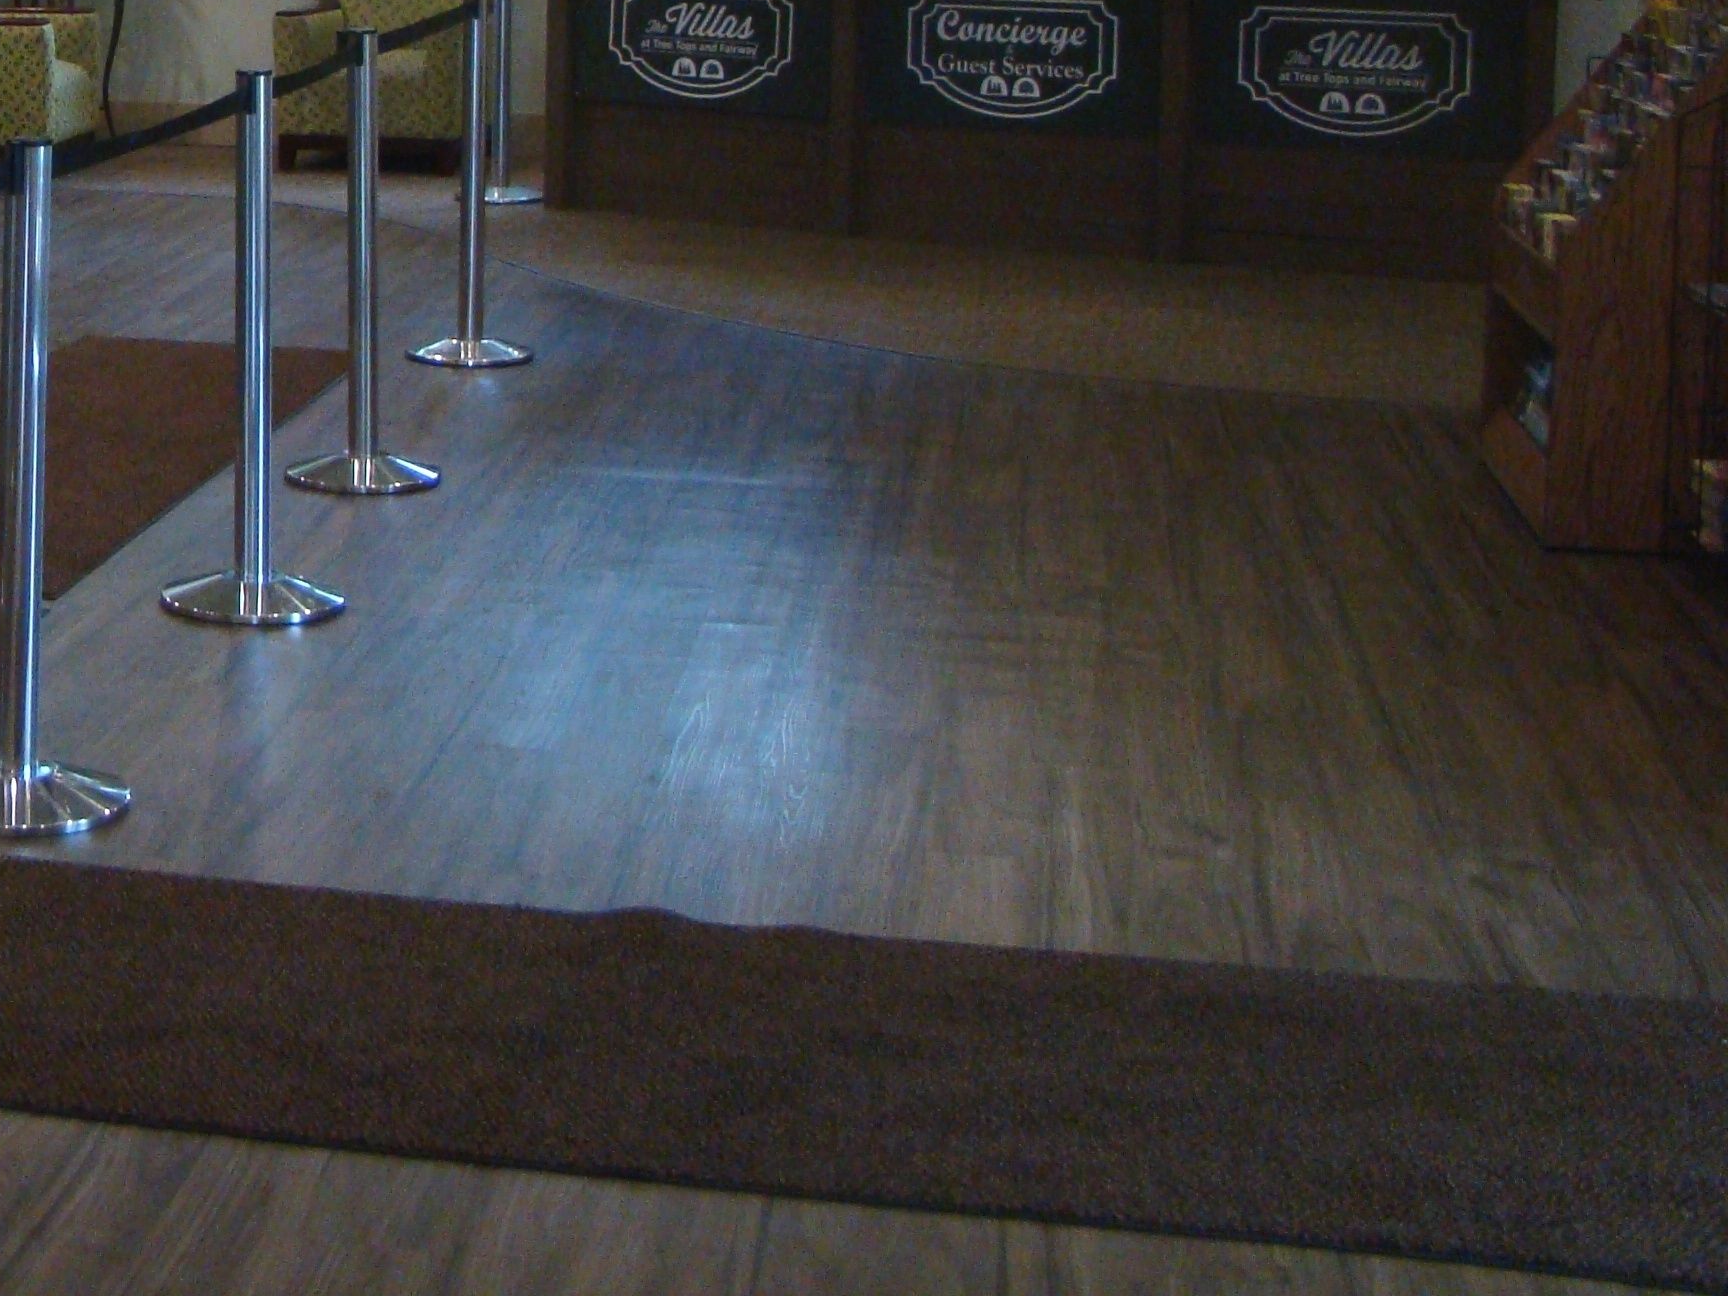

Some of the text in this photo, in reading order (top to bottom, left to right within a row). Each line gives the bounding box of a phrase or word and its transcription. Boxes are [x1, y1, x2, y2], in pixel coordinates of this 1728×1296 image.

[667, 3, 755, 40] Villas
[937, 10, 1088, 56] Concierge
[938, 53, 1084, 79] Guest Services
[1310, 30, 1423, 71] Villas
[1295, 72, 1320, 83] Tree
